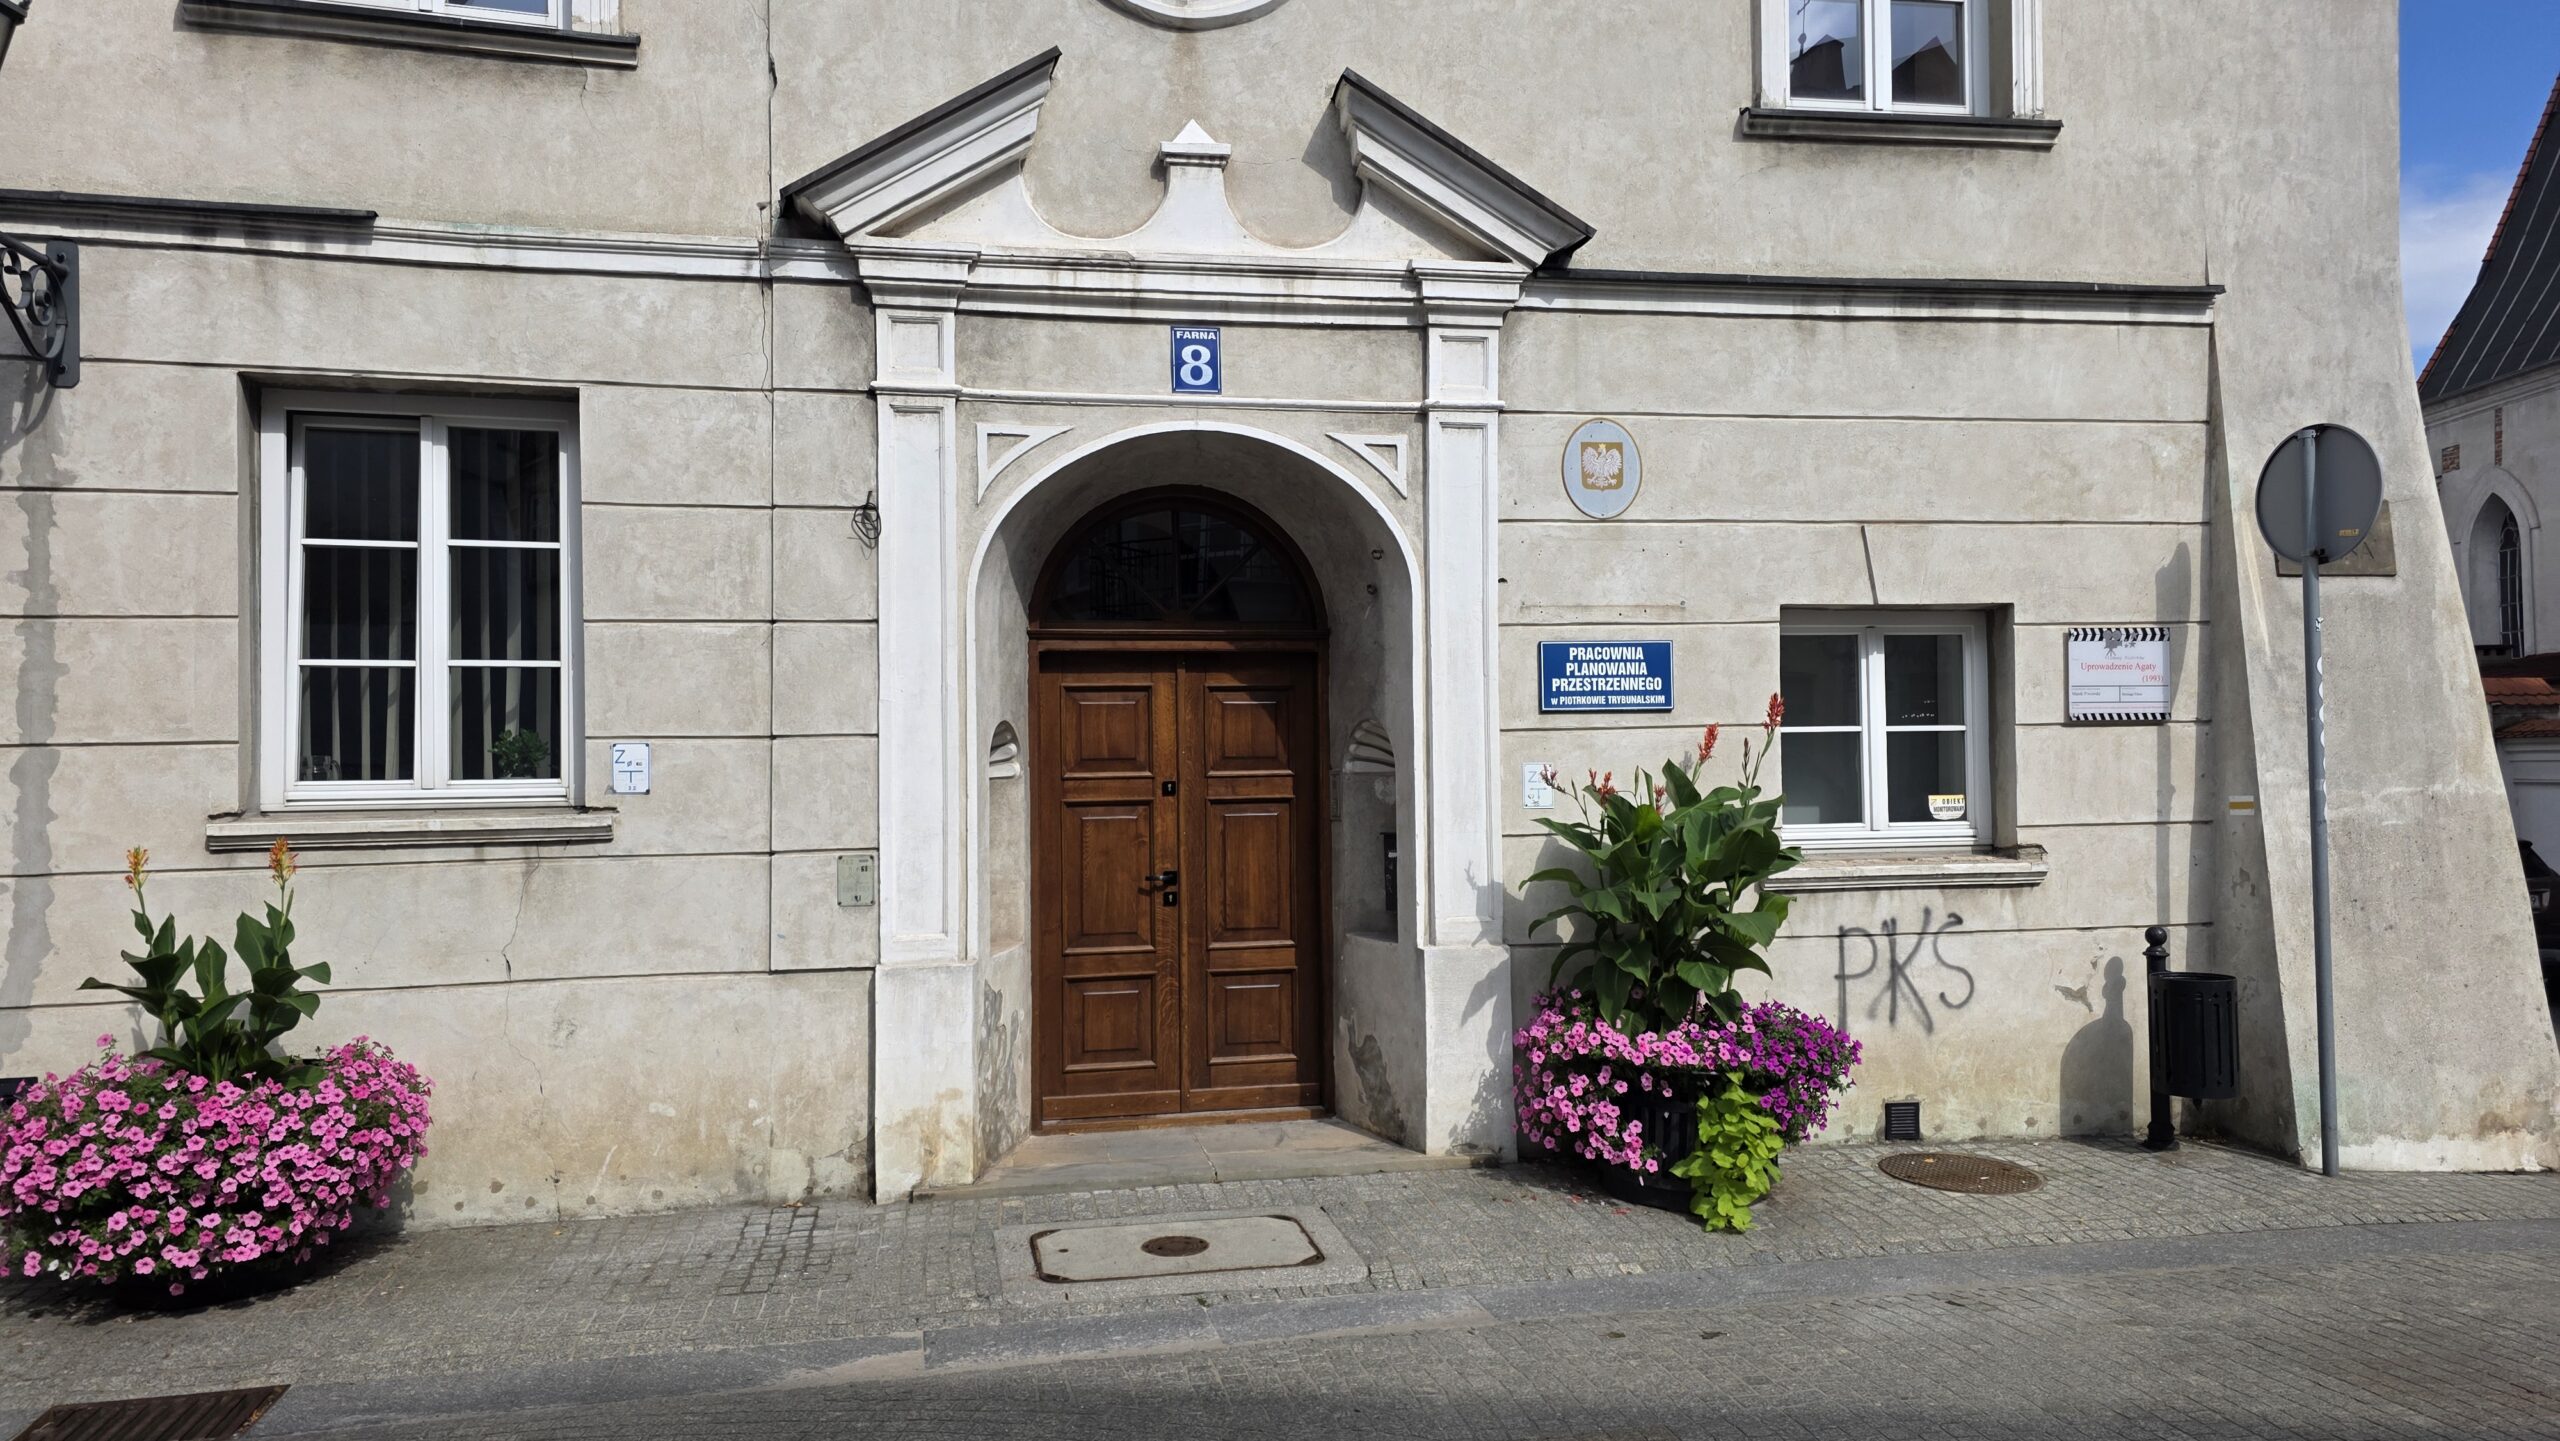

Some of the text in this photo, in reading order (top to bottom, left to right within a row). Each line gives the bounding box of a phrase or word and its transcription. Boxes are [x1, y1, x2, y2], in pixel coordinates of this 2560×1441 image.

[1176, 331, 1217, 340] FARNA
[1180, 344, 1213, 386] 8
[1569, 647, 1644, 660] PRACOWNIA
[1566, 662, 1648, 676] PLANOWANIA
[2080, 663, 2157, 673] Uprowadzenie Agaty
[1552, 677, 1662, 691] PRZESTRZENNEGO
[1560, 696, 1606, 705] PIOTRKOWIE
[1608, 695, 1666, 704] TRYBUNALSKIM
[615, 750, 625, 764] Z
